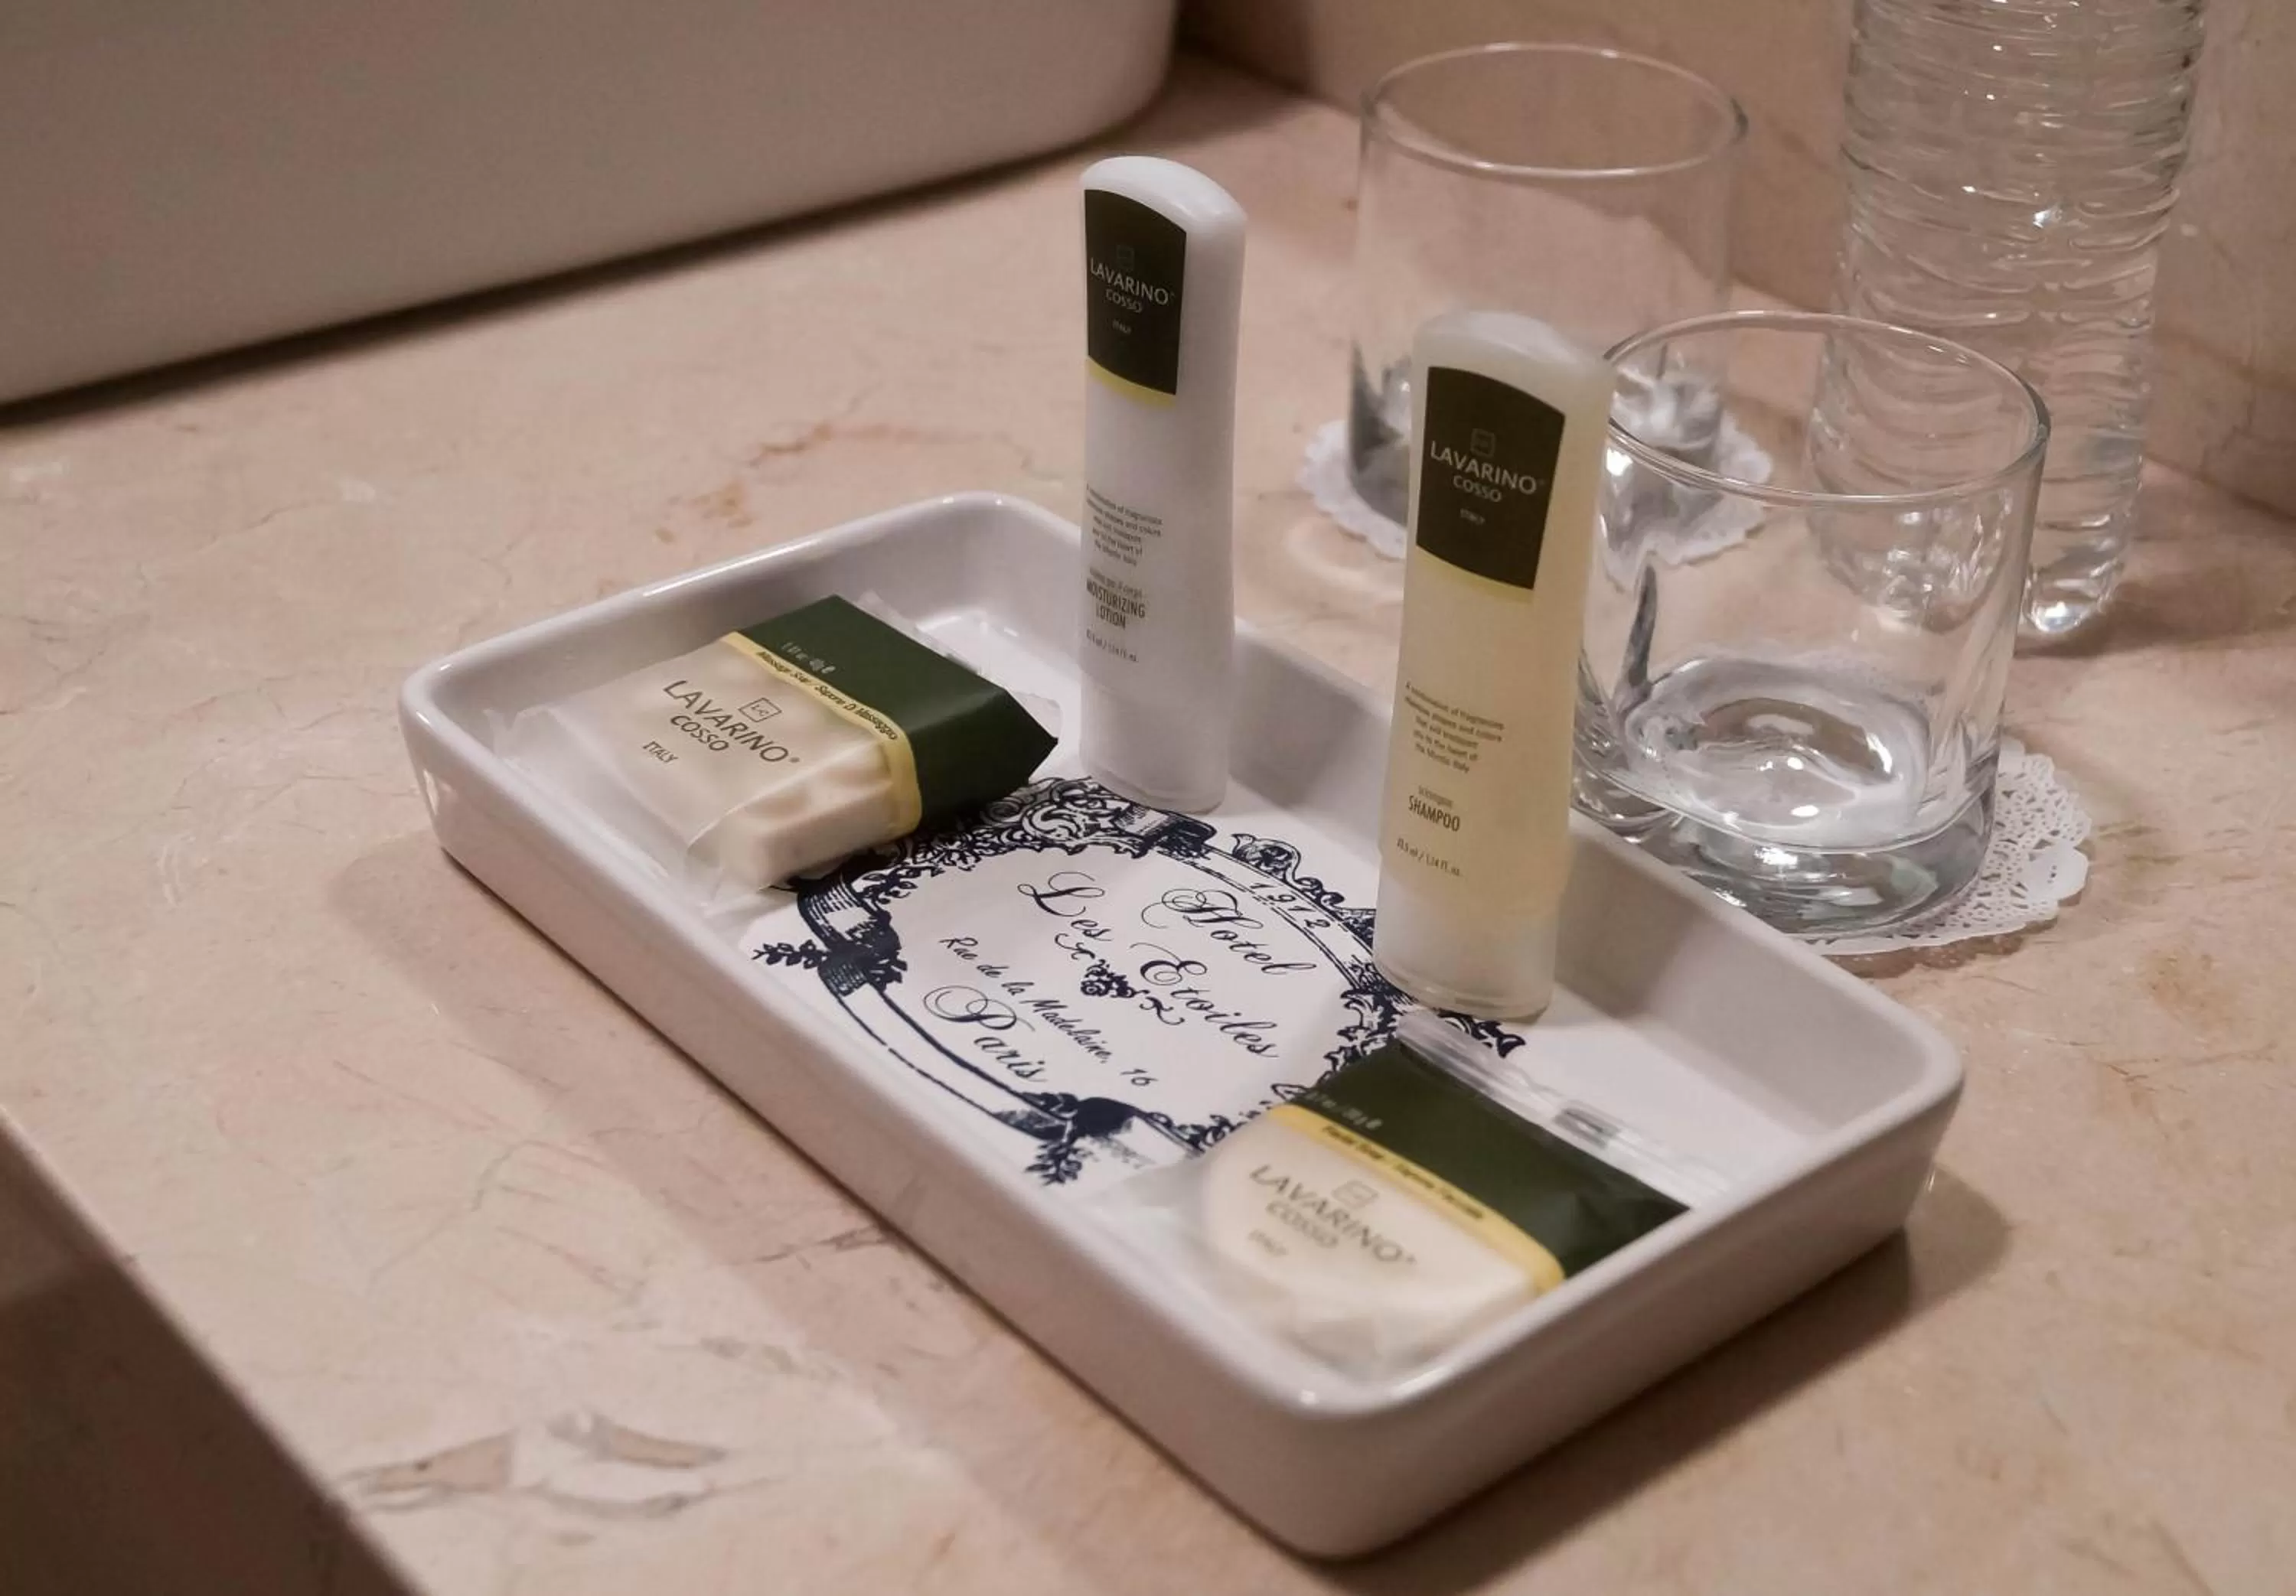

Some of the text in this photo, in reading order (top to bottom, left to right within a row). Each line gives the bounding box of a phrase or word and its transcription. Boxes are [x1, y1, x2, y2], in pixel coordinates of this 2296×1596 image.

[1105, 288, 1143, 314] COSSO
[1453, 474, 1503, 503] COSSO
[1095, 601, 1127, 630] LOTION
[670, 714, 730, 752] COSSO
[642, 741, 680, 764] ITALY
[1408, 795, 1461, 832] SHAMPOO
[1250, 882, 1331, 929] 1912
[1141, 888, 1318, 976] Hotel
[1016, 870, 1280, 1060] Les Etoiles
[938, 936, 980, 960] Rue
[976, 964, 1009, 979] de
[1000, 981, 1035, 996] la
[1120, 1067, 1159, 1087] 16
[923, 984, 1049, 1083] Paris
